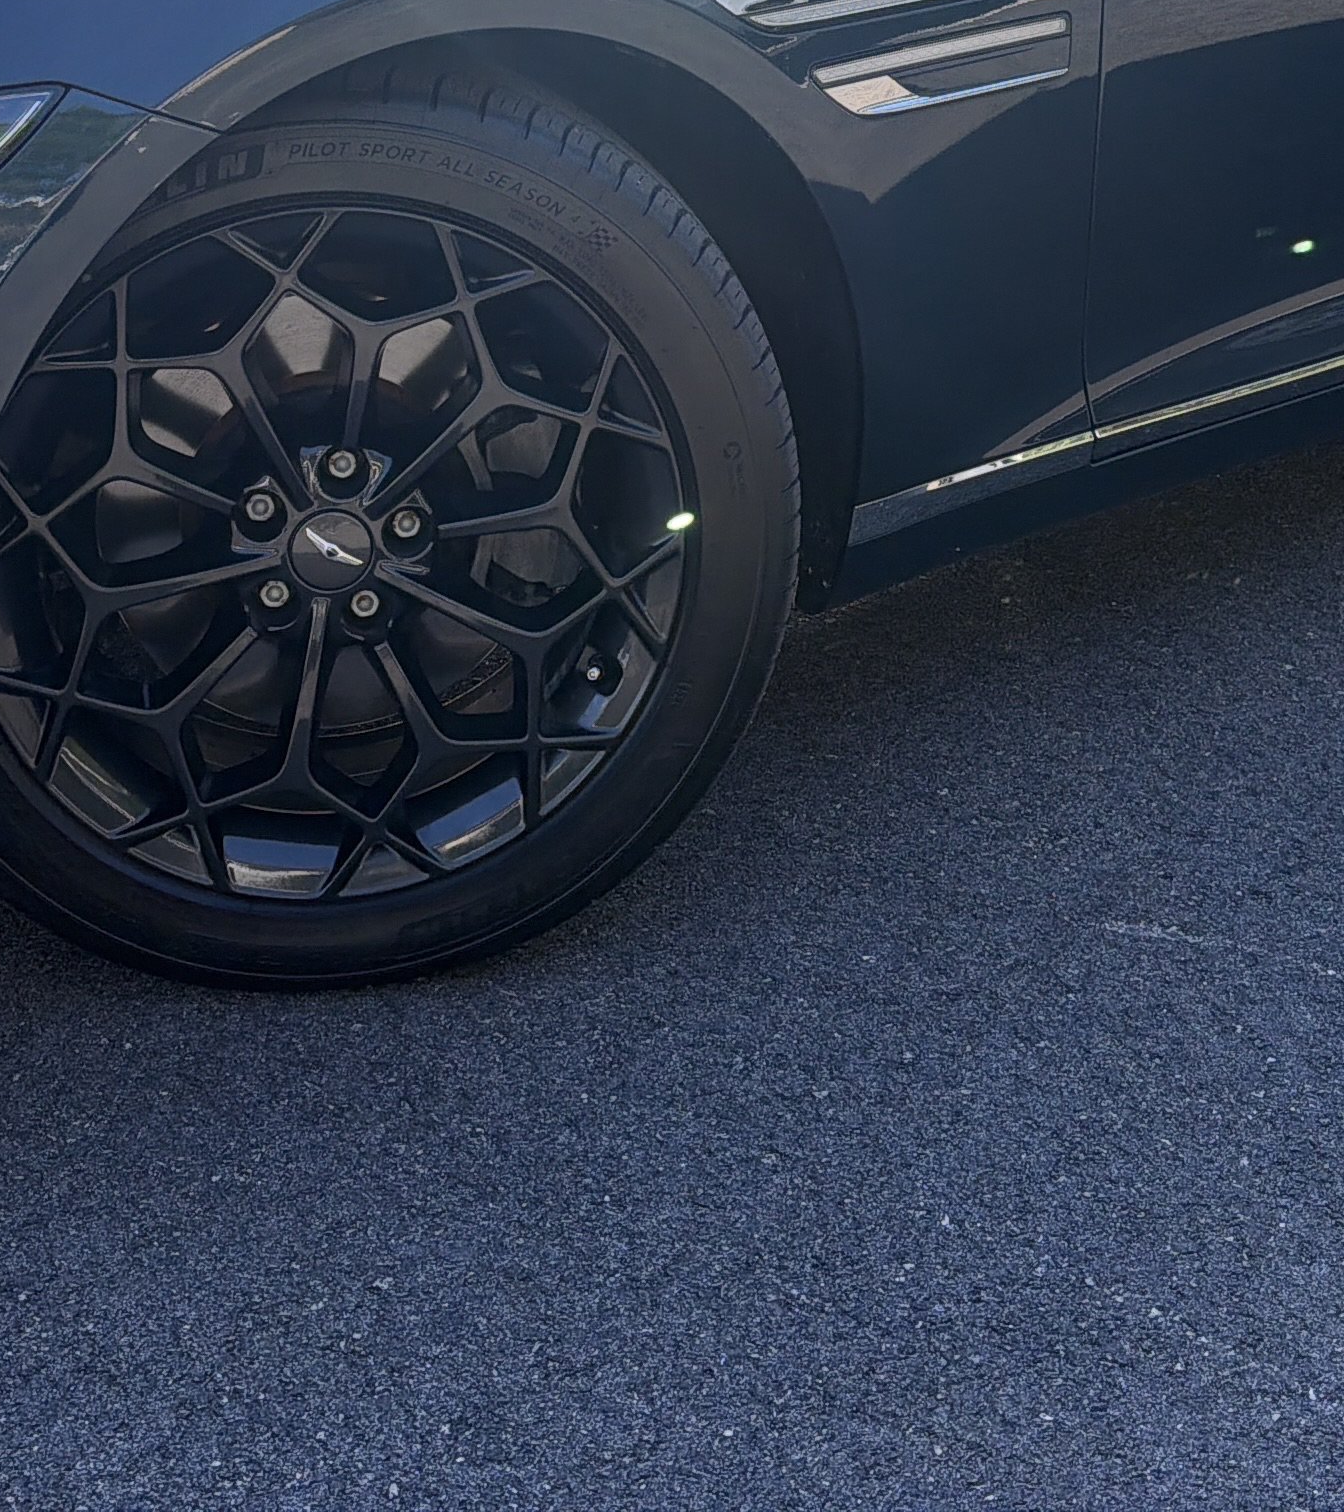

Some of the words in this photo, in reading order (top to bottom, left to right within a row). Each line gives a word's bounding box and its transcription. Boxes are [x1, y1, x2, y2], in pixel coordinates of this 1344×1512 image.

[288, 141, 351, 159] PILOT
[358, 142, 433, 165] SPORT
[436, 155, 475, 178] ALL
[483, 169, 567, 217] SEASON
